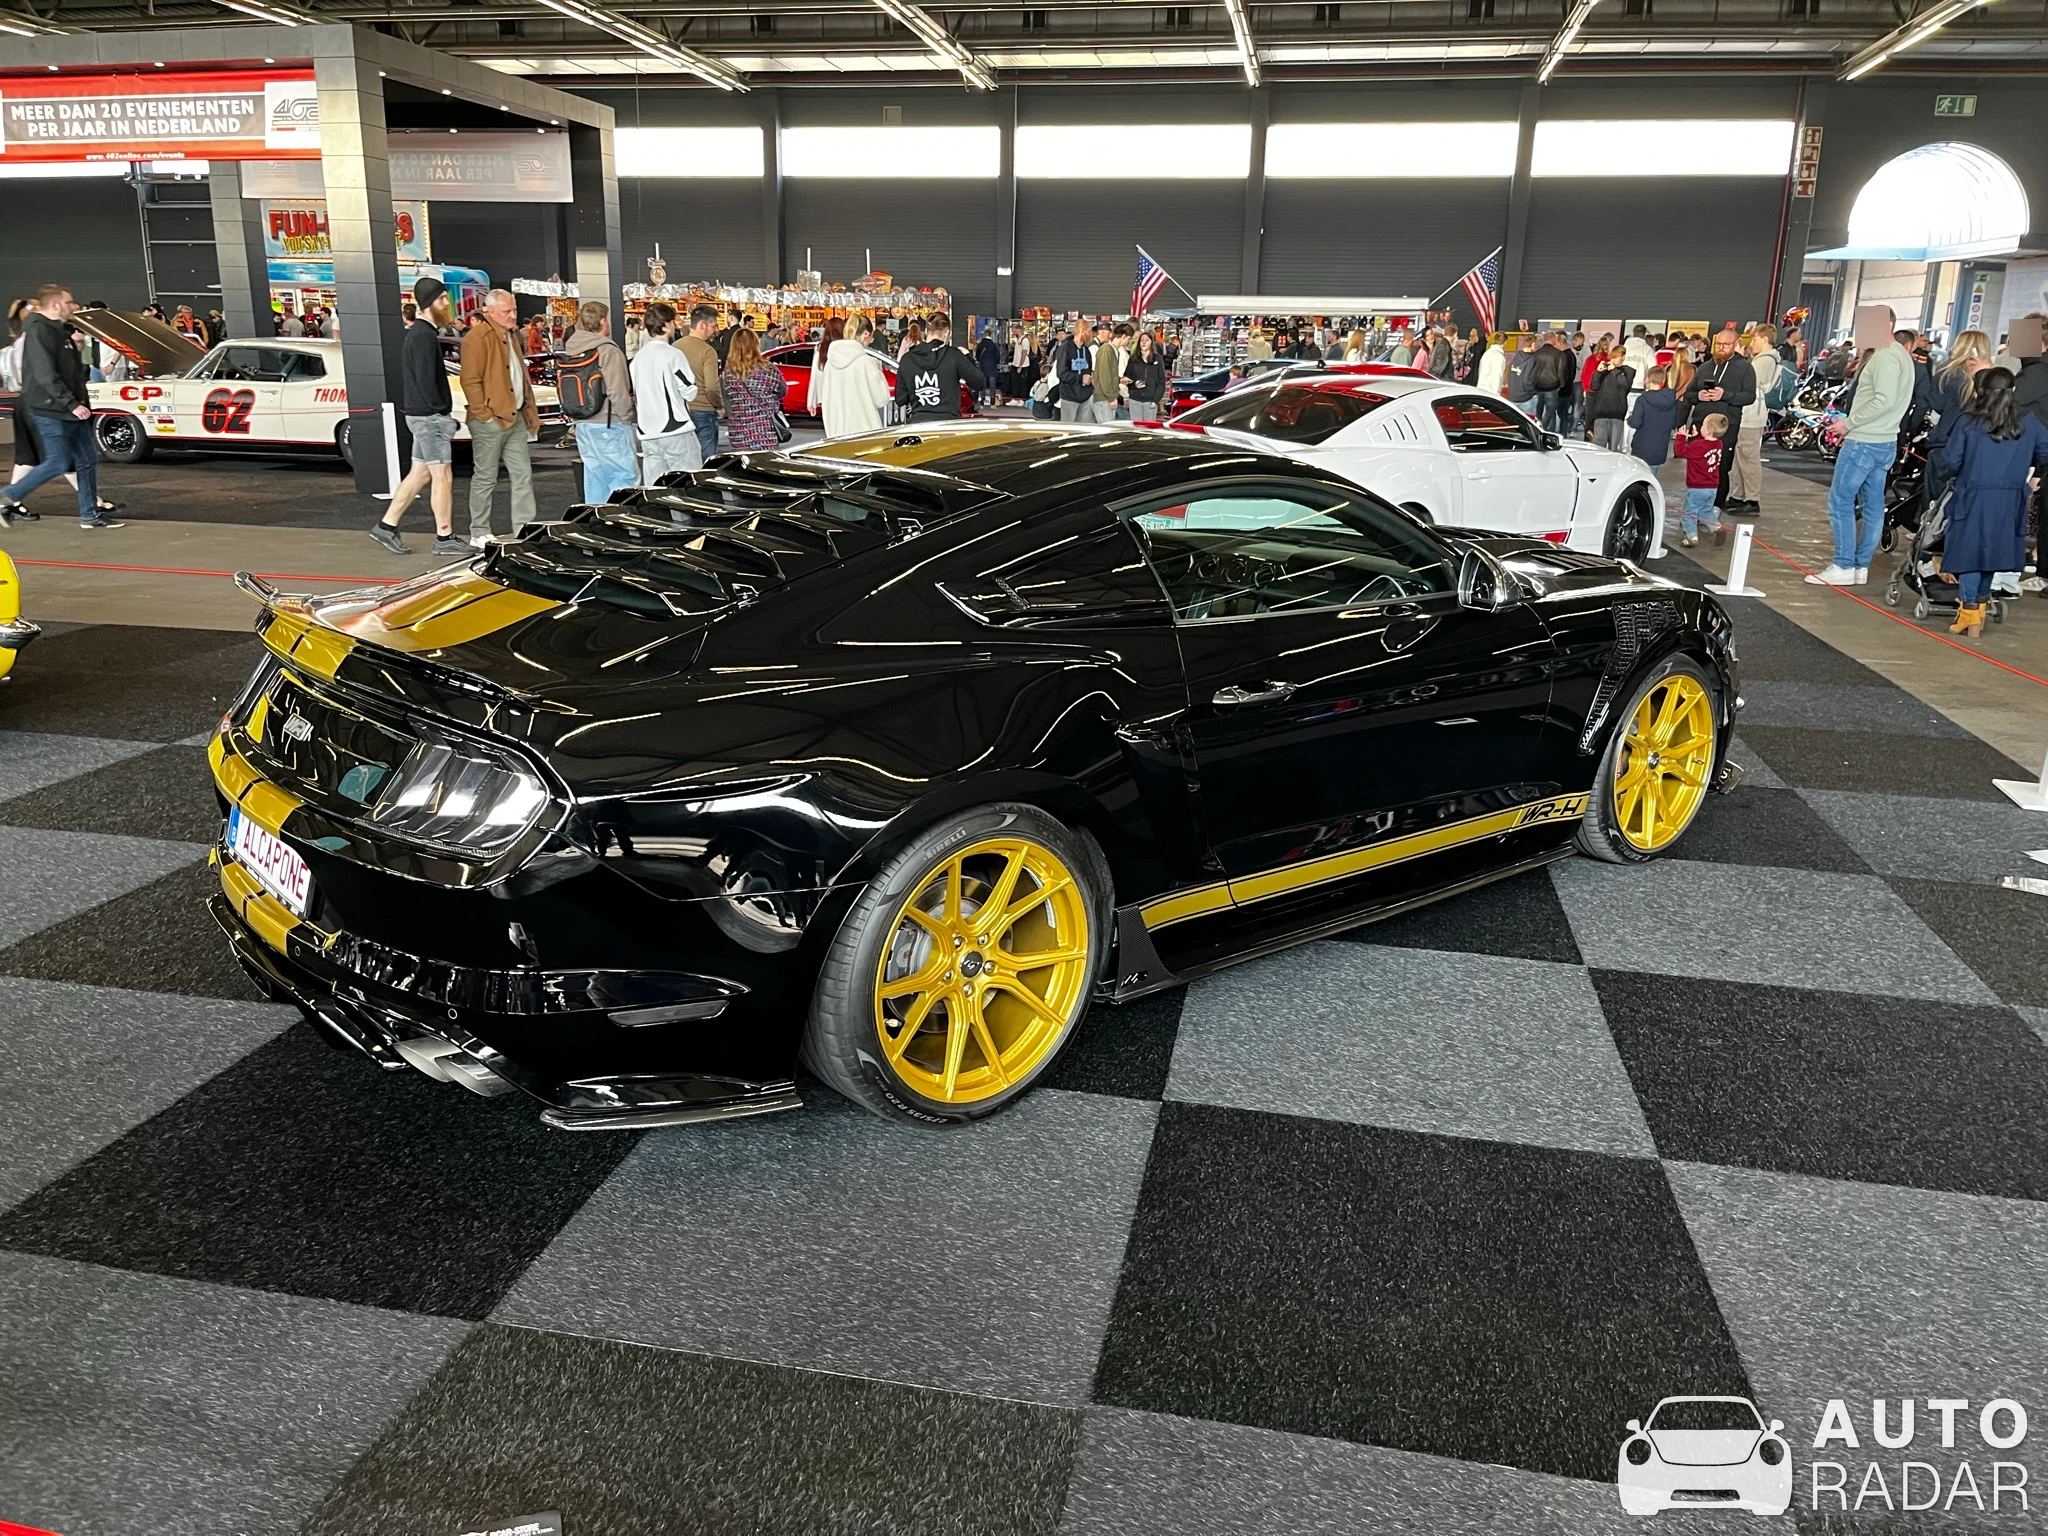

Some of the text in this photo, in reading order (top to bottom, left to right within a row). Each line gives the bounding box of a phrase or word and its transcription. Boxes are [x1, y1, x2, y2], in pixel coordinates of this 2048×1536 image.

[11, 99, 255, 120] MEER DAN 20 EVENEMENTEN
[28, 117, 241, 138] PER JAAR IN NEDERLAND
[85, 151, 186, 160] www.402online.com/events
[119, 385, 163, 401] CP
[201, 387, 256, 434] 62
[1520, 798, 1583, 824] WR-H
[924, 828, 967, 860] PIRELLI
[243, 820, 309, 901] ALCAPONE
